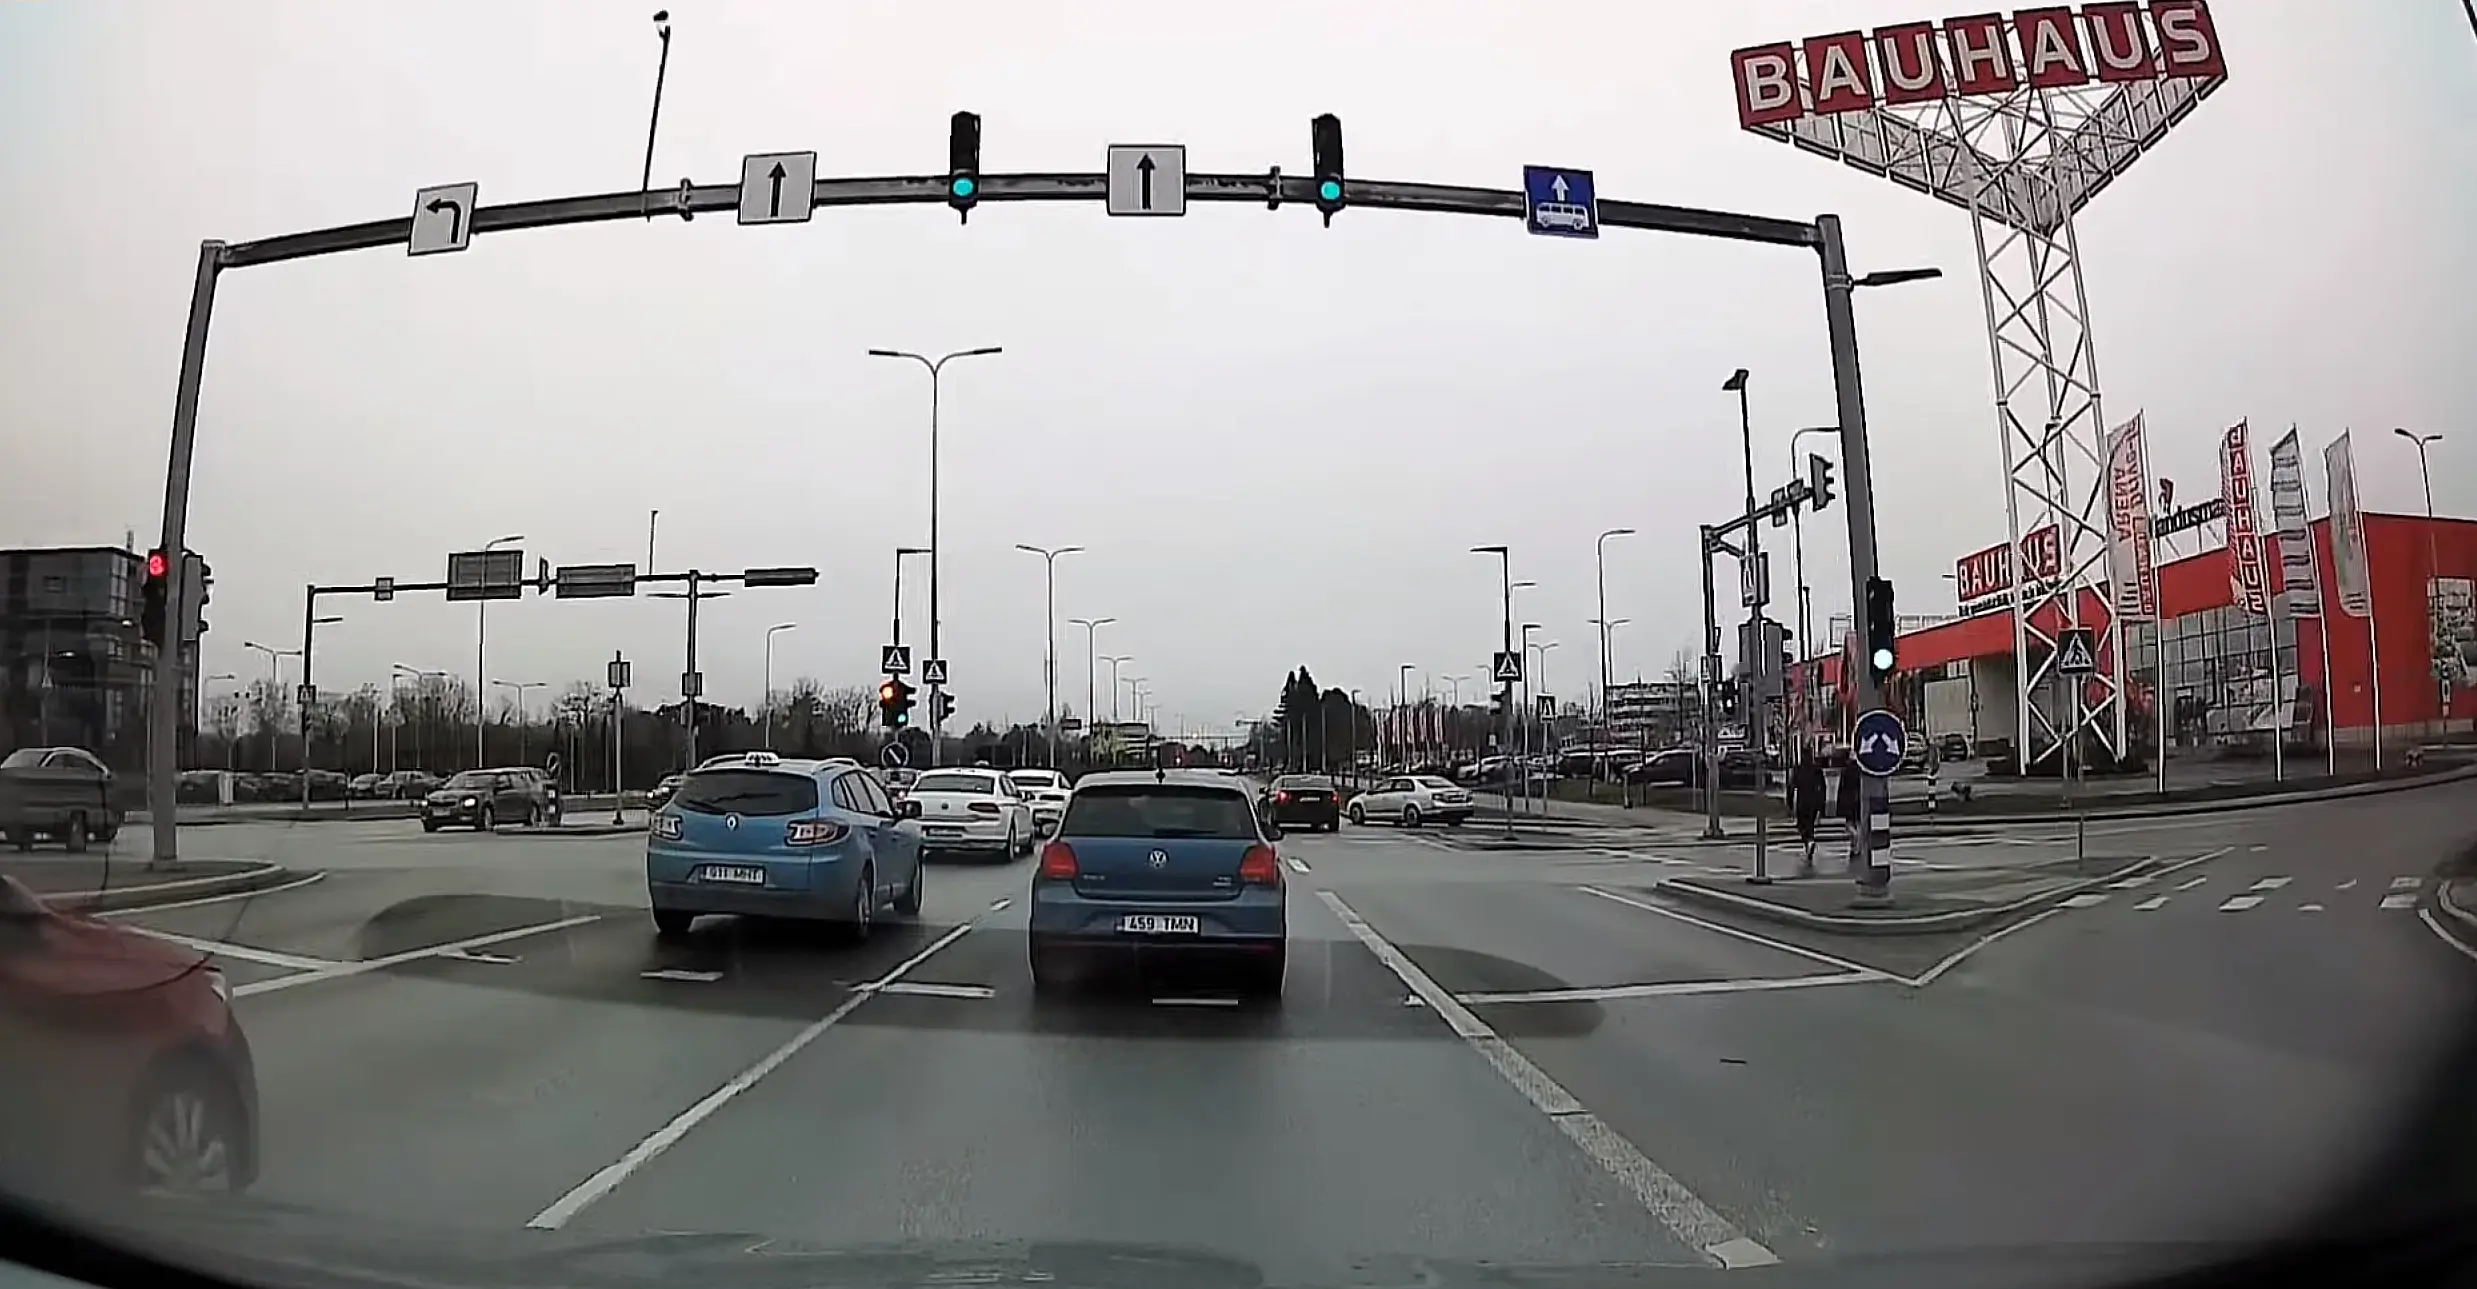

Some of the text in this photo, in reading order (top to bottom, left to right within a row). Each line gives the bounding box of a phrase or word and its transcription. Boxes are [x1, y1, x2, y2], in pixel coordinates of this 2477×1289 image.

[1742, 9, 2211, 112] BAUHAUS
[1960, 530, 2058, 598] BAUHUS
[1129, 917, 1155, 930] 459
